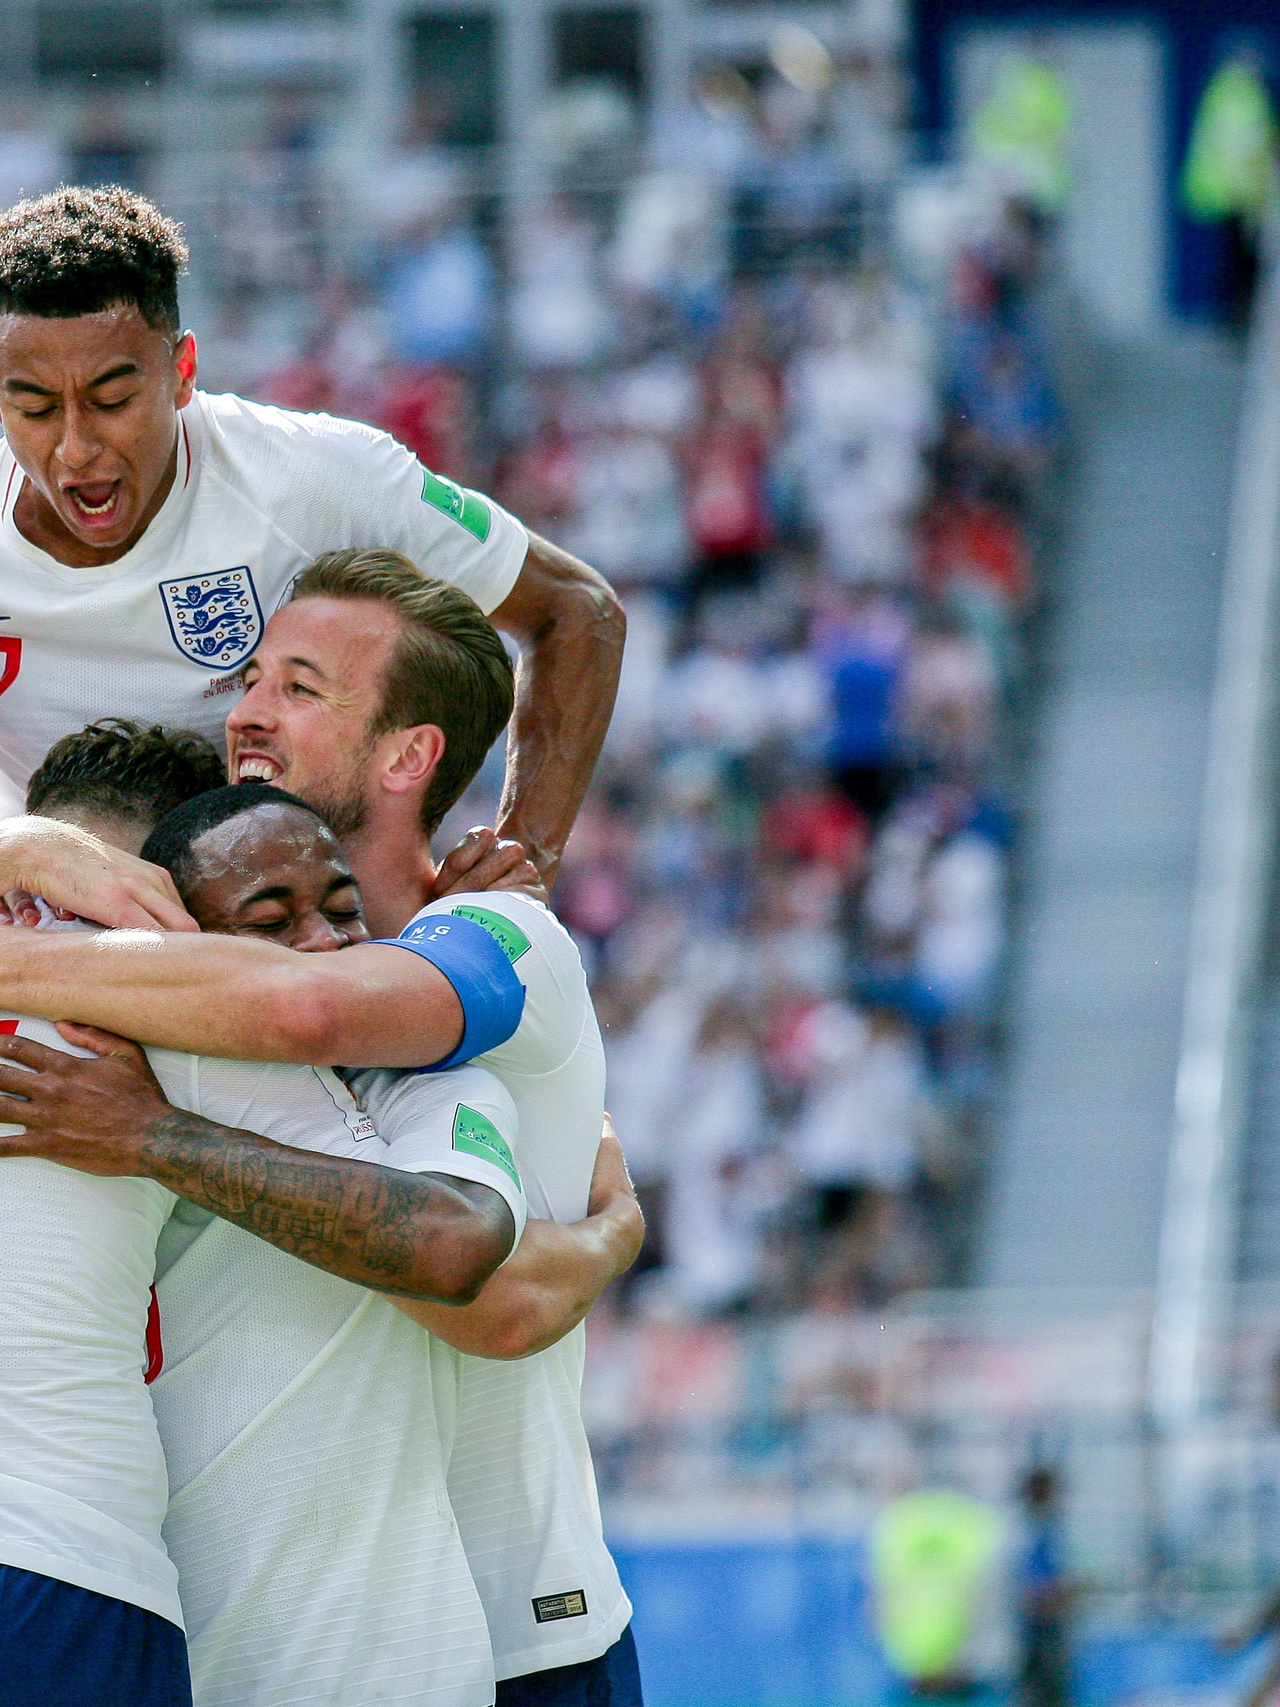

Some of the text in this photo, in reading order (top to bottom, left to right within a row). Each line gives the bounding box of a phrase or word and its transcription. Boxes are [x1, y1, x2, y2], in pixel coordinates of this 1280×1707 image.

[216, 681, 236, 695] JUNE
[457, 909, 517, 956] LIVING
[352, 1121, 374, 1135] RUSS
